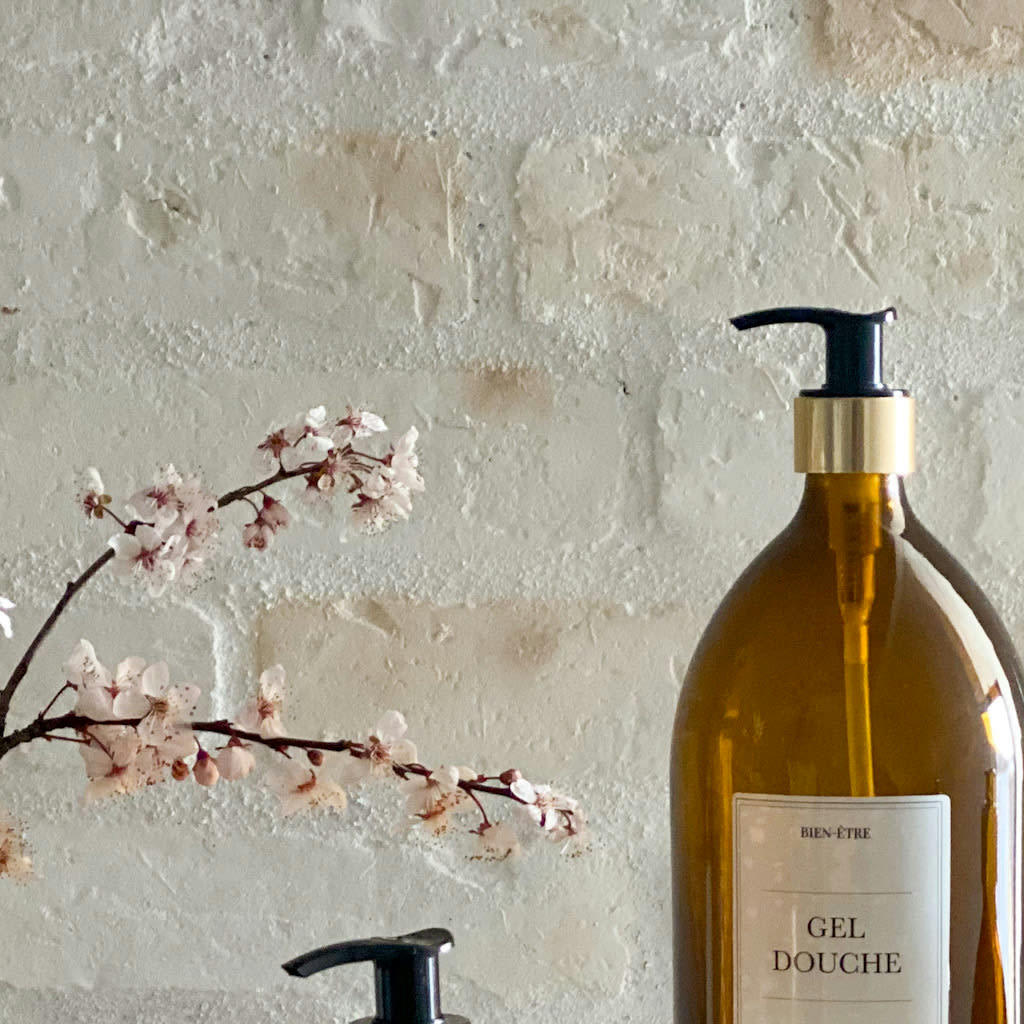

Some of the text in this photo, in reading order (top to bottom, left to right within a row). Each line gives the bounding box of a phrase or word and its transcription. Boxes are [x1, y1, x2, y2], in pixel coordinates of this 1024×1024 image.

[801, 825, 871, 840] BIEN-ÊTRE
[807, 916, 866, 939] GEL
[772, 950, 902, 974] DOUCHE
